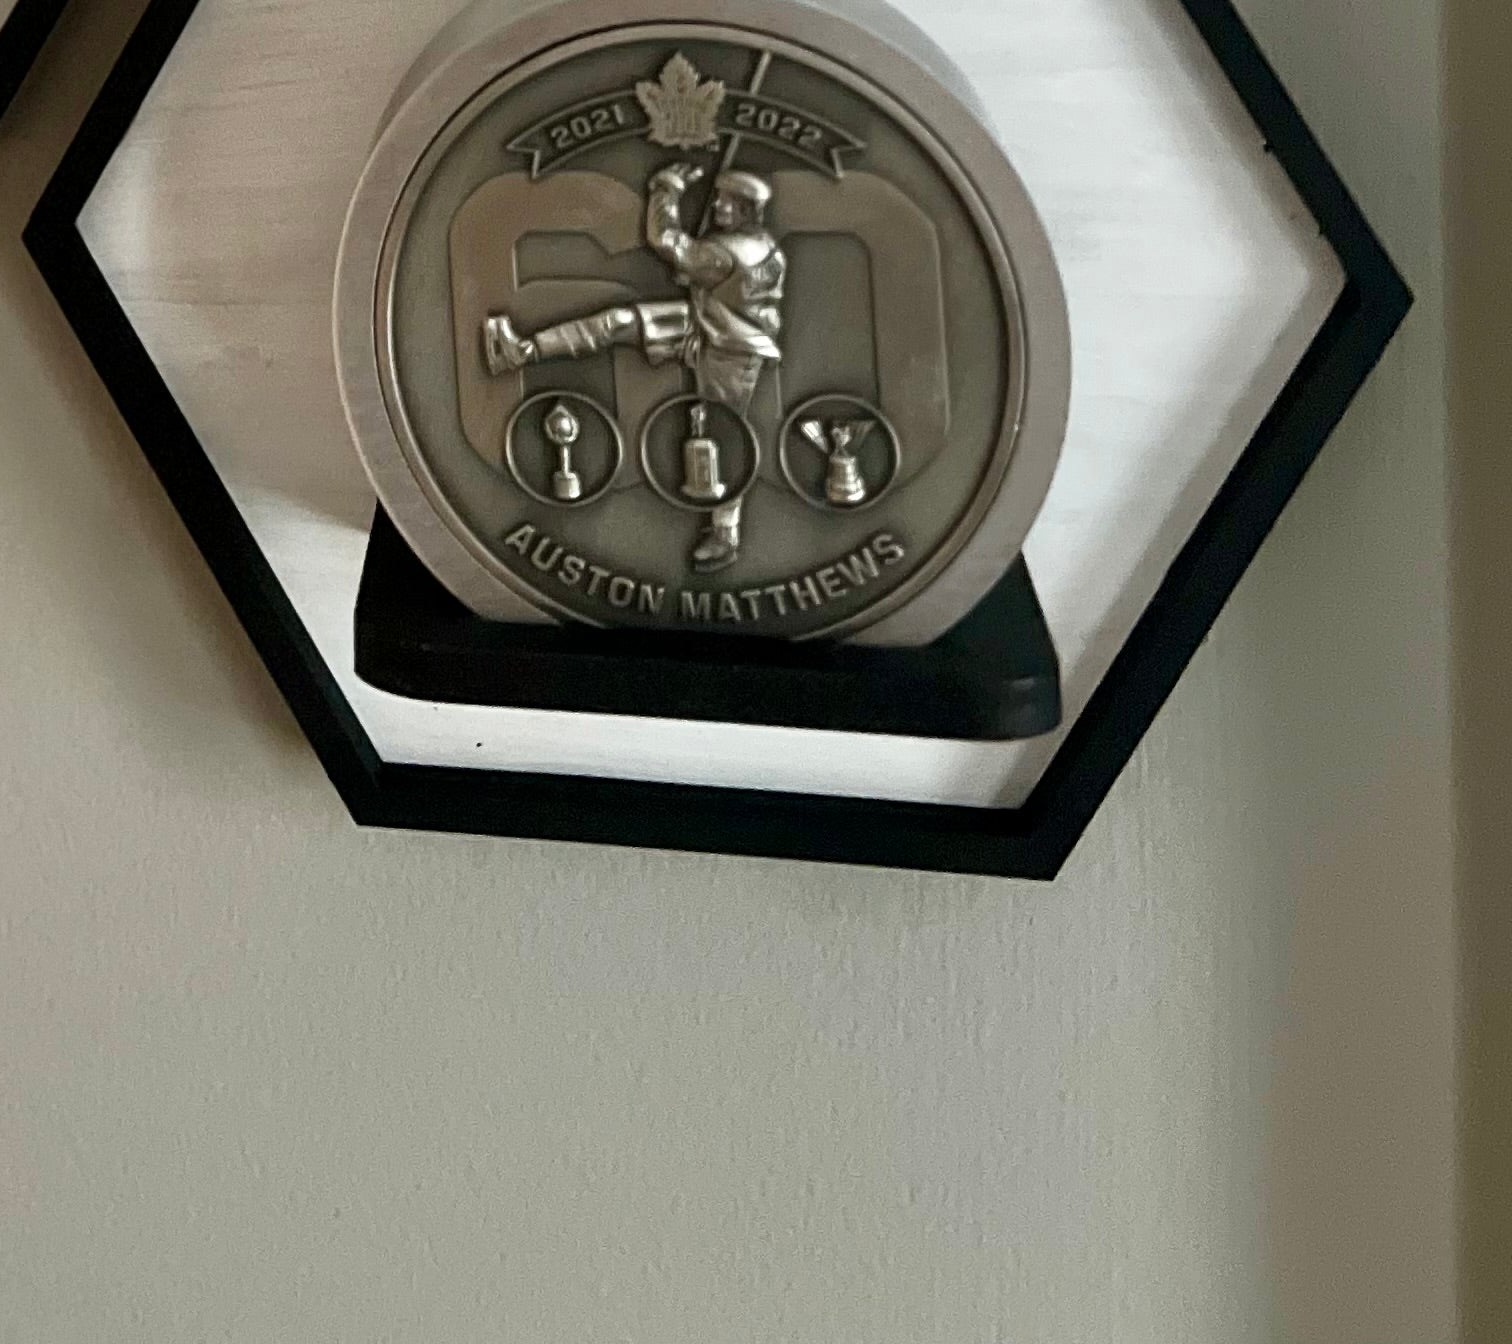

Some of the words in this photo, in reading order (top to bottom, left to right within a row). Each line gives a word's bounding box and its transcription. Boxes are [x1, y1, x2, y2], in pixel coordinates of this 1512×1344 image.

[550, 104, 625, 149] 2021
[735, 103, 822, 144] 2022
[504, 523, 665, 614] AUSTON
[681, 533, 905, 621] MATTHEWS
